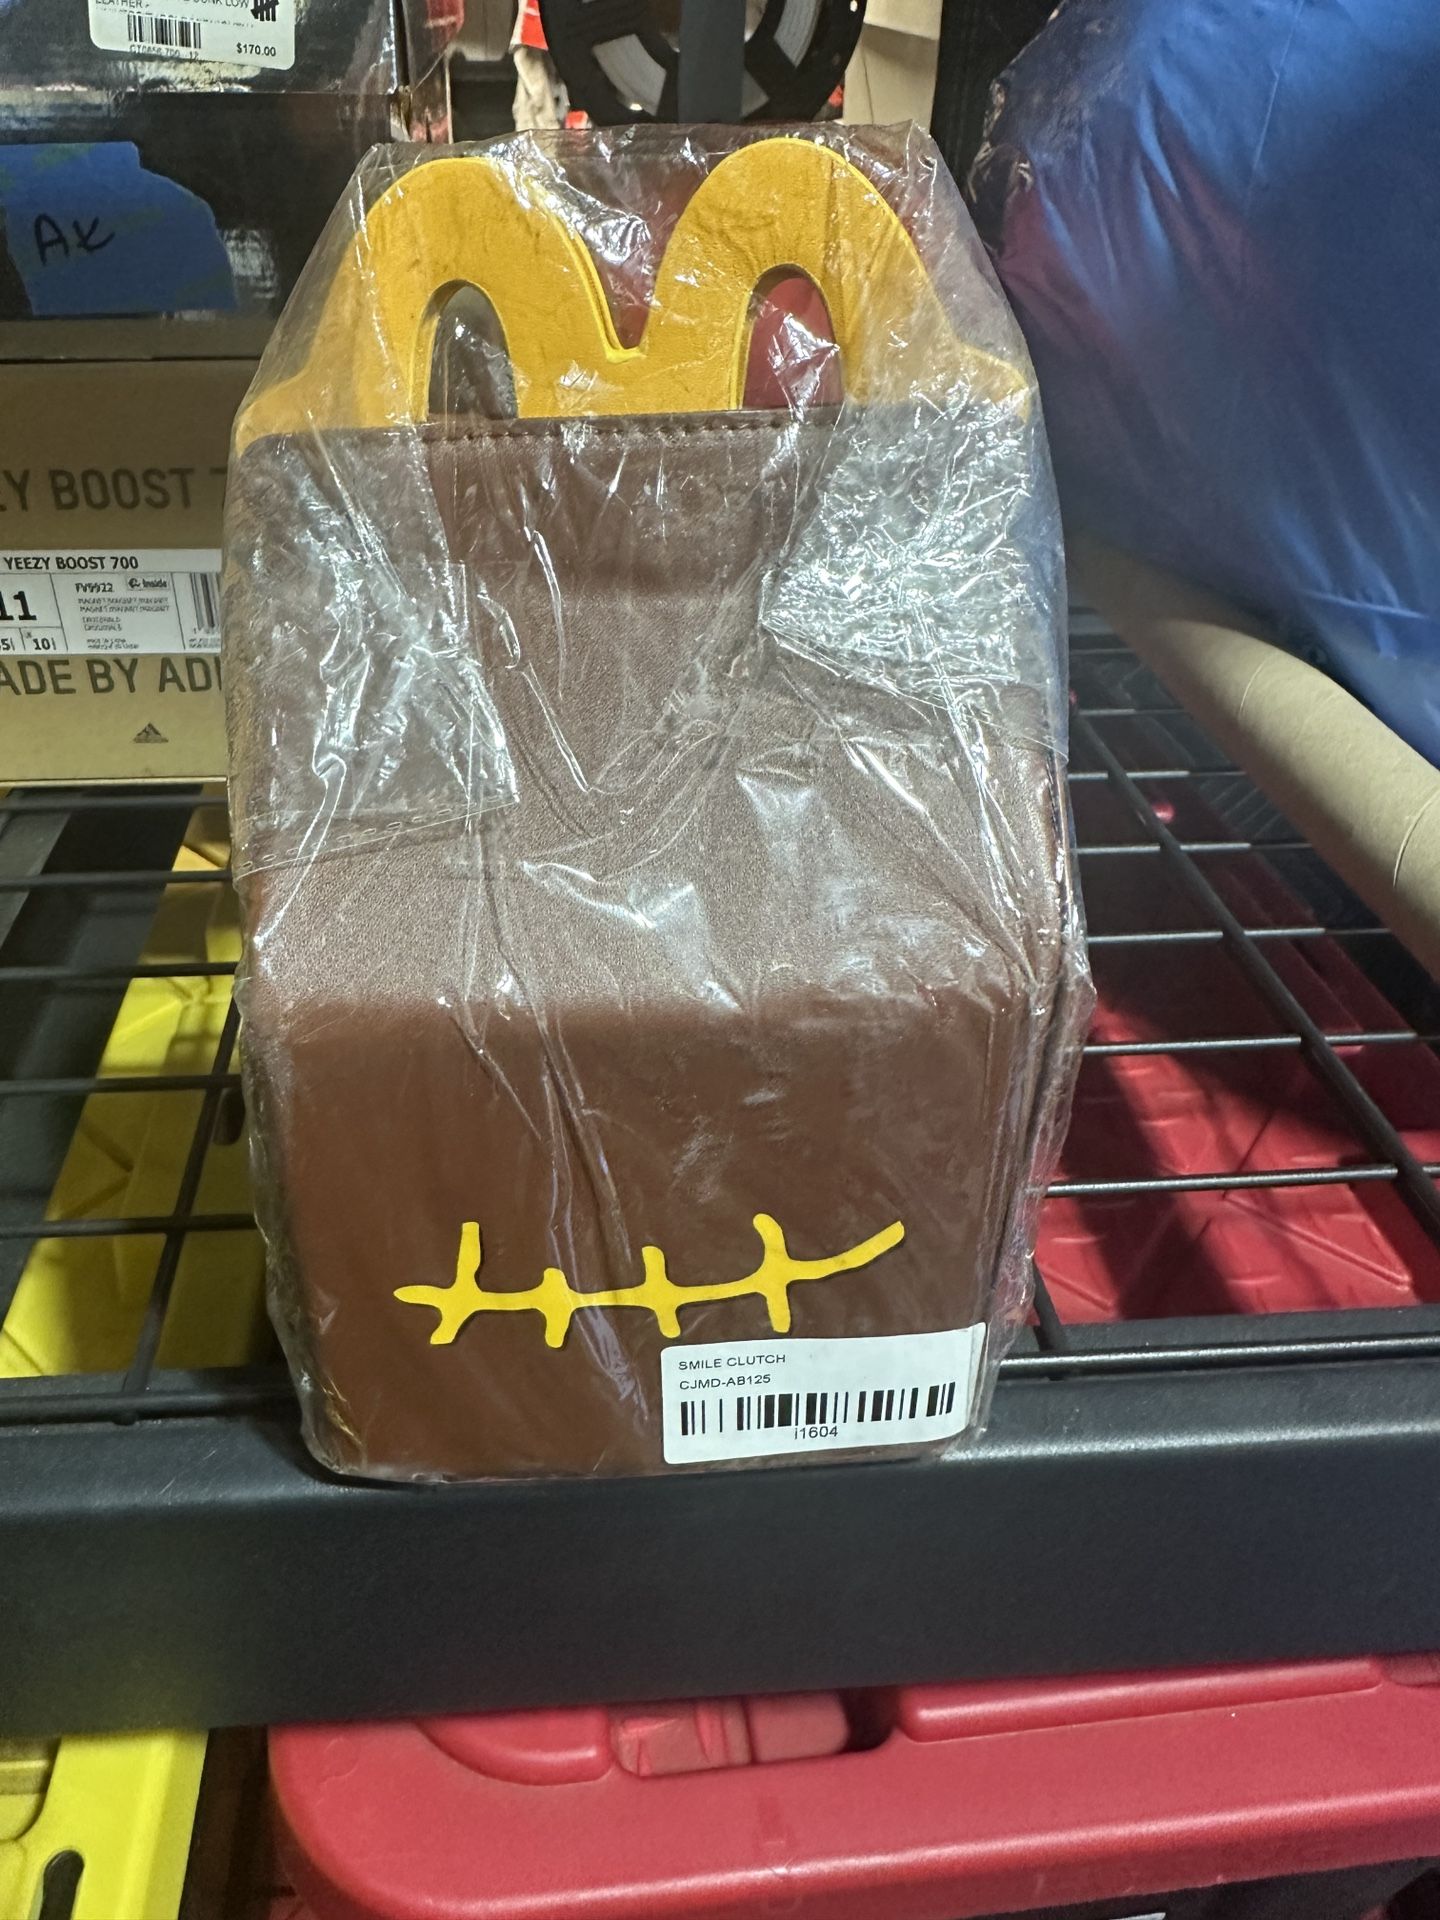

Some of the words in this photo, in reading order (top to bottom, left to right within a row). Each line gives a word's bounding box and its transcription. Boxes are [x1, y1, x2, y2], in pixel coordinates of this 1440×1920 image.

[236, 42, 277, 57] $170.00
[49, 467, 195, 511] BOOST
[3, 556, 51, 570] YEEZY
[55, 556, 106, 570] BOOST
[110, 556, 139, 570] 700
[86, 658, 139, 693] BY
[678, 1358, 722, 1370] SMILE
[726, 1354, 786, 1367] CLUTCH
[679, 1374, 771, 1390] CJMD-AB125
